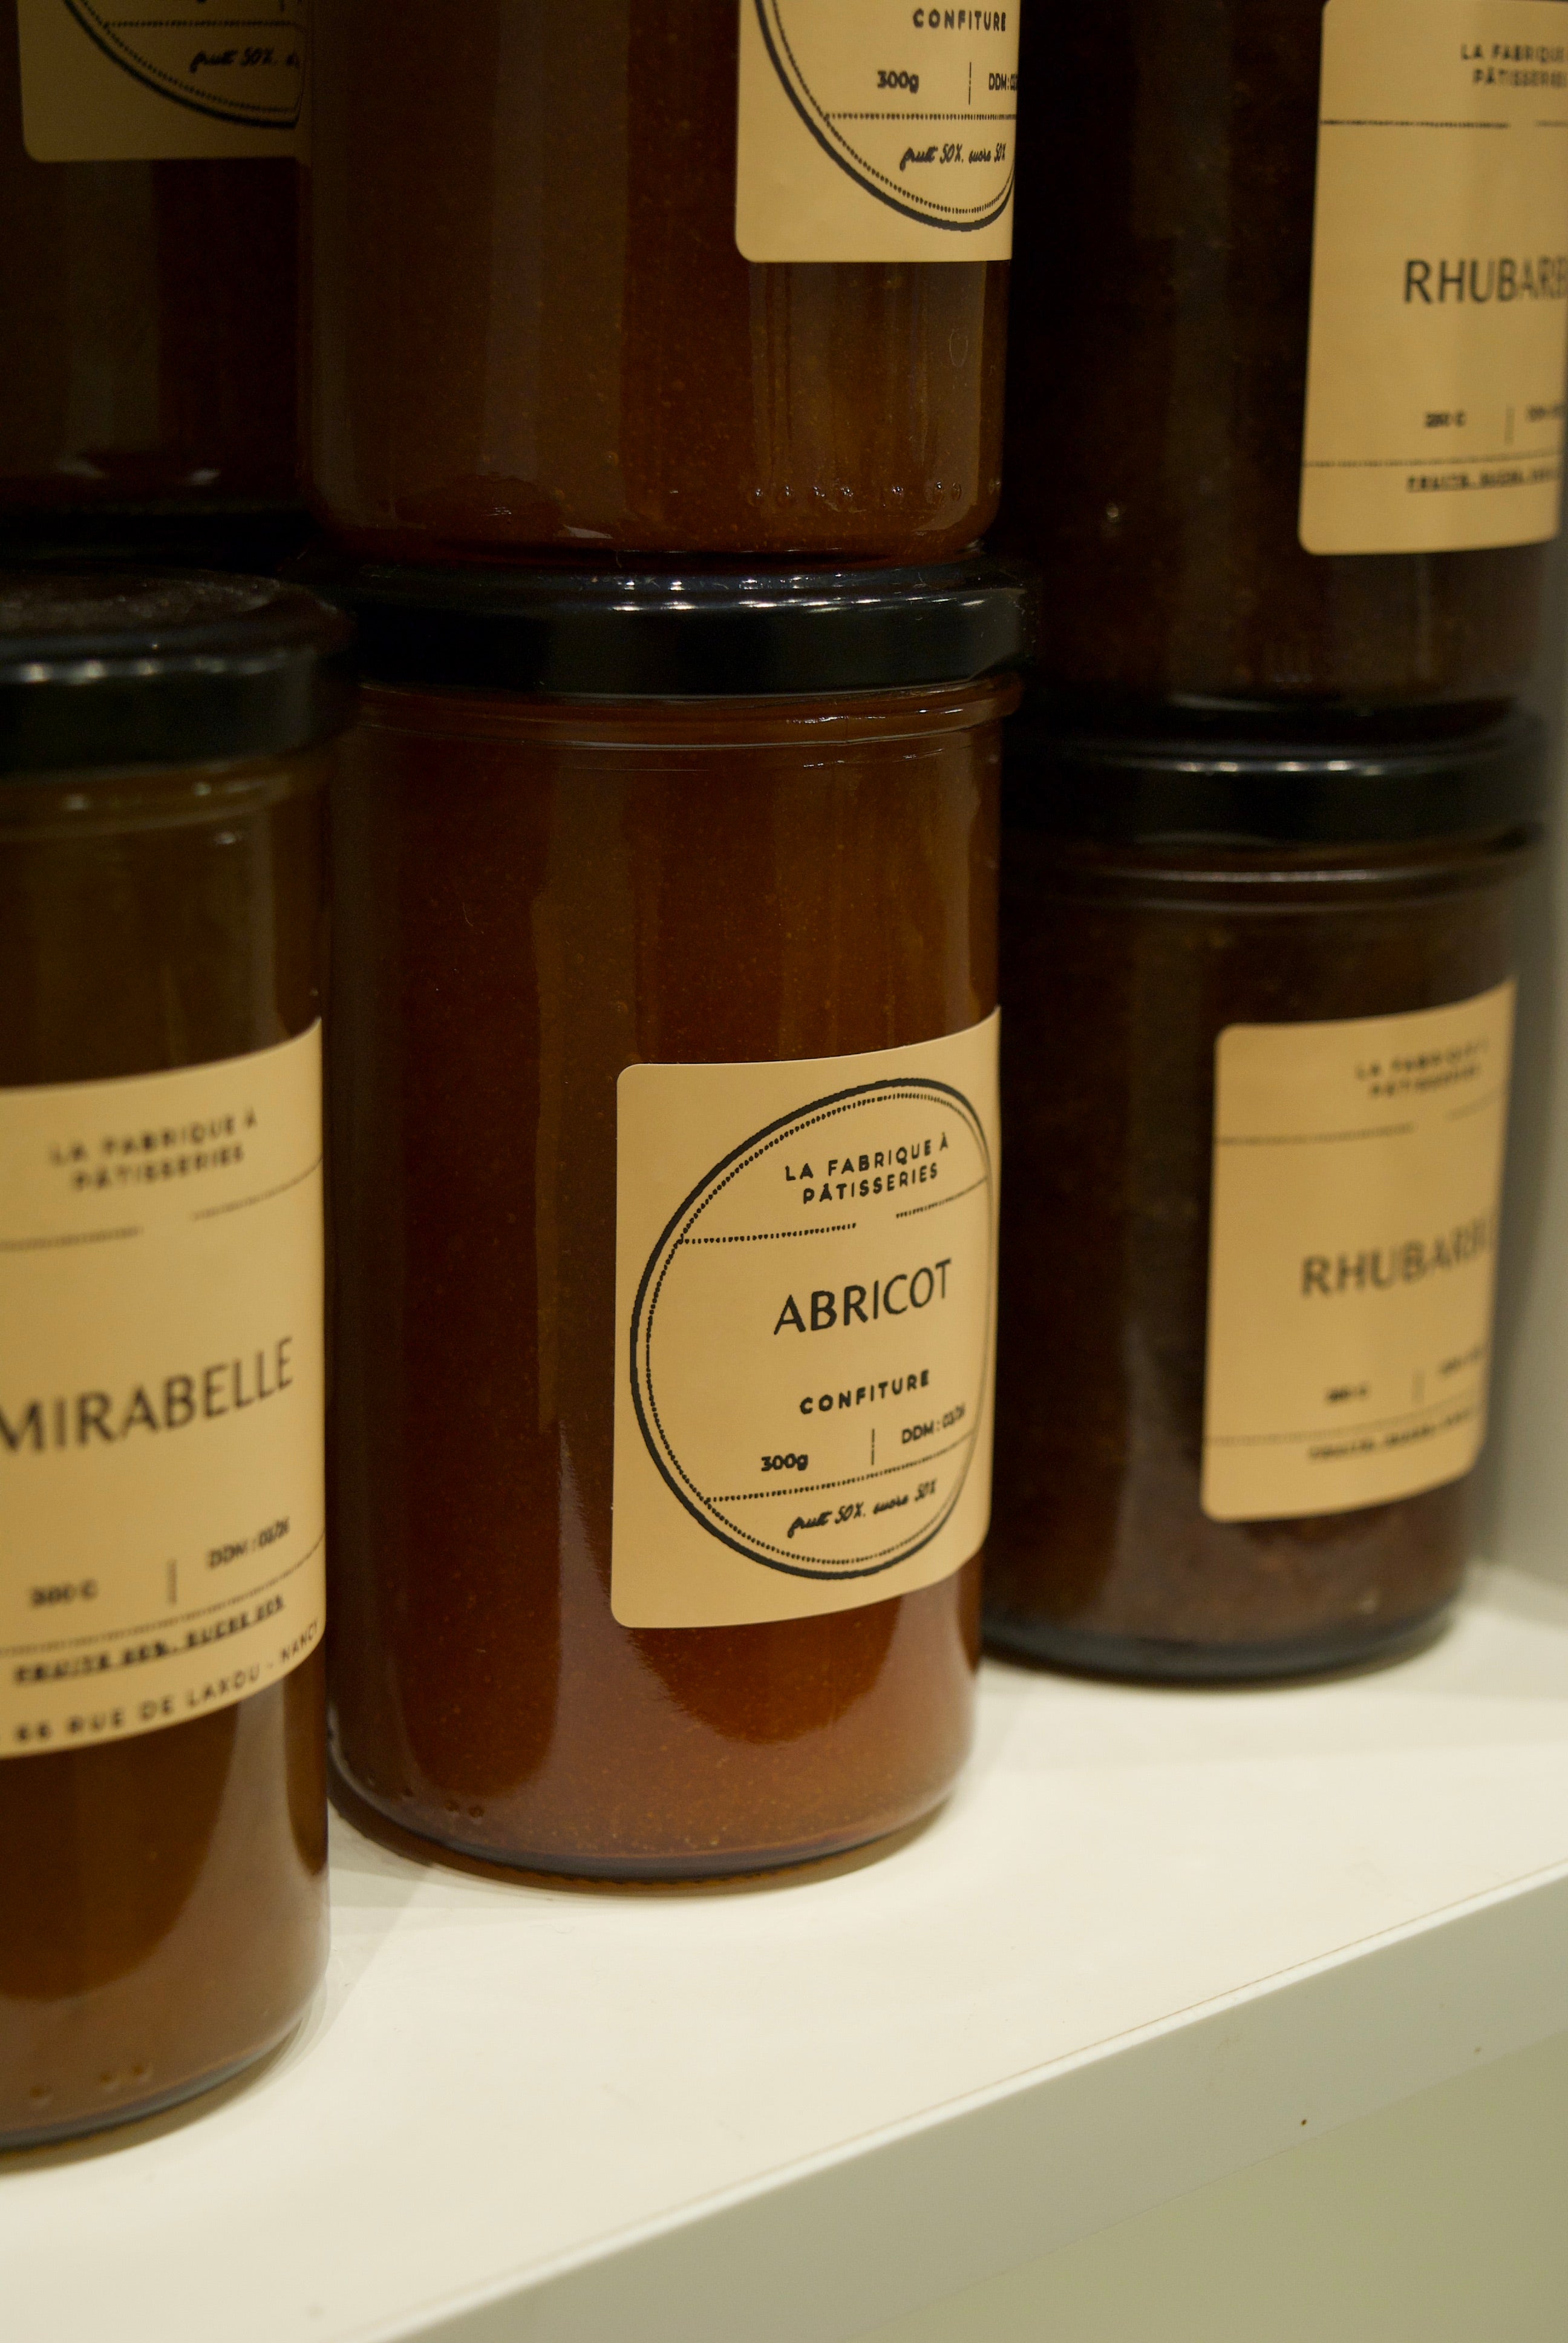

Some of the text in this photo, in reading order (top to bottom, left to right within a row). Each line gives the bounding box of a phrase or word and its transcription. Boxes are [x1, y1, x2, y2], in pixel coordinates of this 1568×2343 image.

[912, 8, 1007, 32] CONFITURE
[877, 70, 920, 94] 300g
[101, 1113, 236, 1156] FABRIQUE
[785, 1131, 949, 1182] LA FABRIQUE À
[803, 1161, 939, 1205] PÂTISSERIES
[773, 1257, 952, 1336] ABRICOT
[0, 1335, 293, 1455] MIRABELLE
[799, 1368, 930, 1416] CONFITURE
[760, 1453, 809, 1472] 300g
[67, 1706, 125, 1734] RUE
[139, 1694, 174, 1721] DE
[187, 1663, 260, 1709] LAXOU
